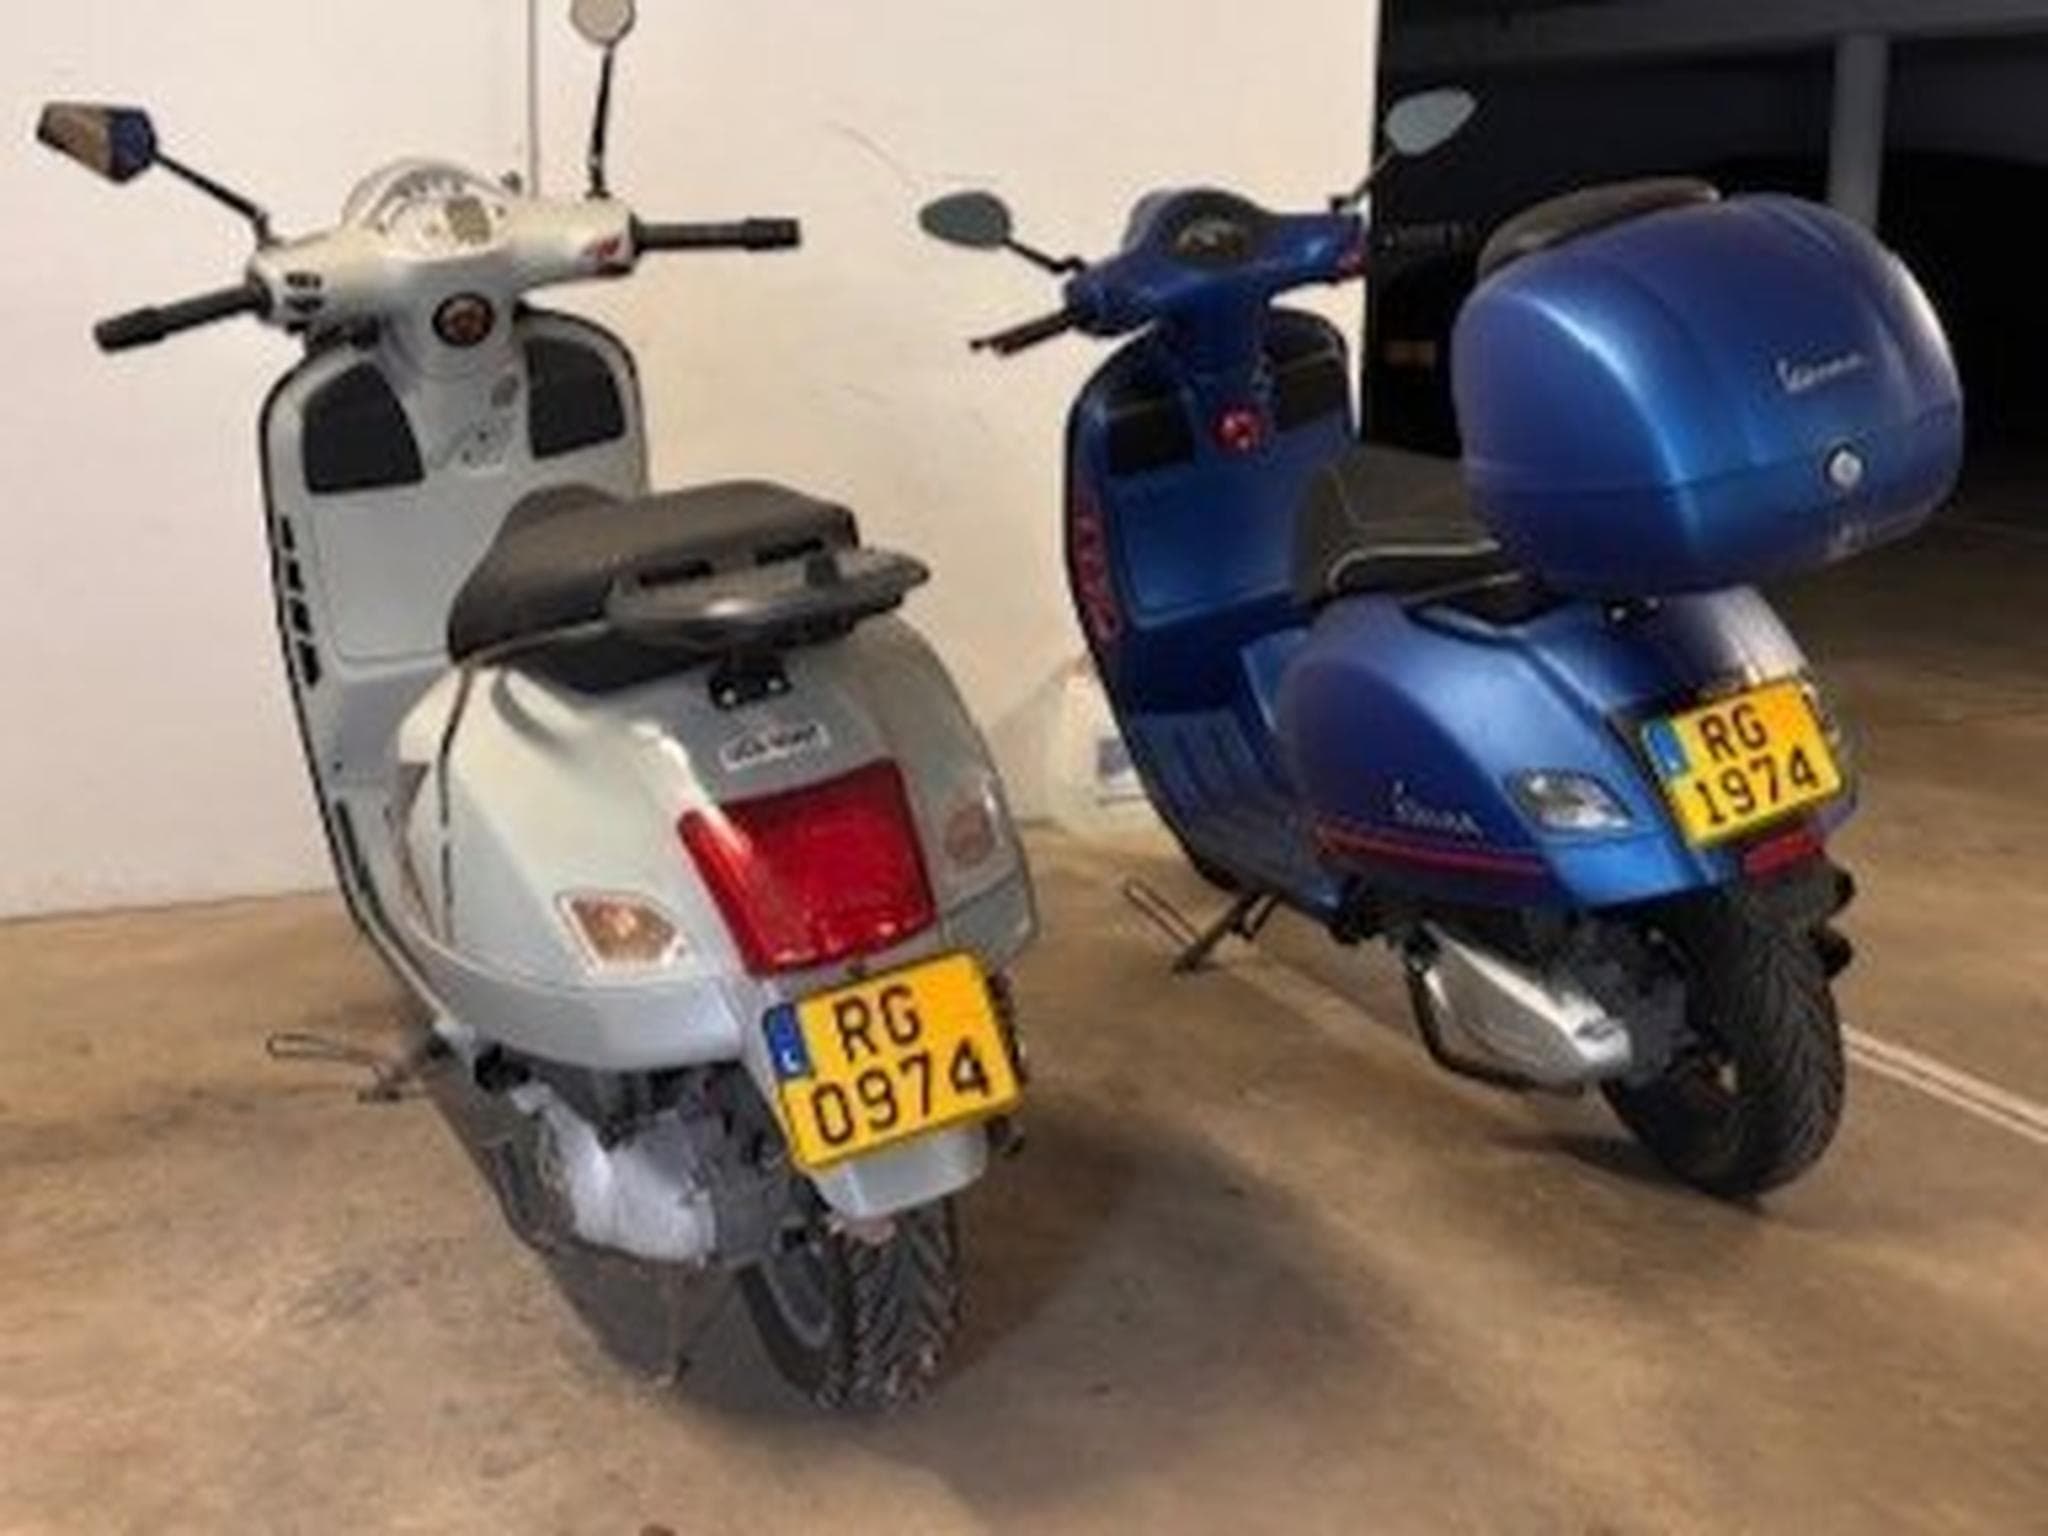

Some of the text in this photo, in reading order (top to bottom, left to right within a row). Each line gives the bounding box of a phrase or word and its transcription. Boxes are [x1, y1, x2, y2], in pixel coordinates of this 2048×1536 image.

[1699, 703, 1767, 762] RG
[1695, 746, 1819, 824] 1974
[832, 985, 921, 1062] RG
[810, 1036, 989, 1145] 0974
